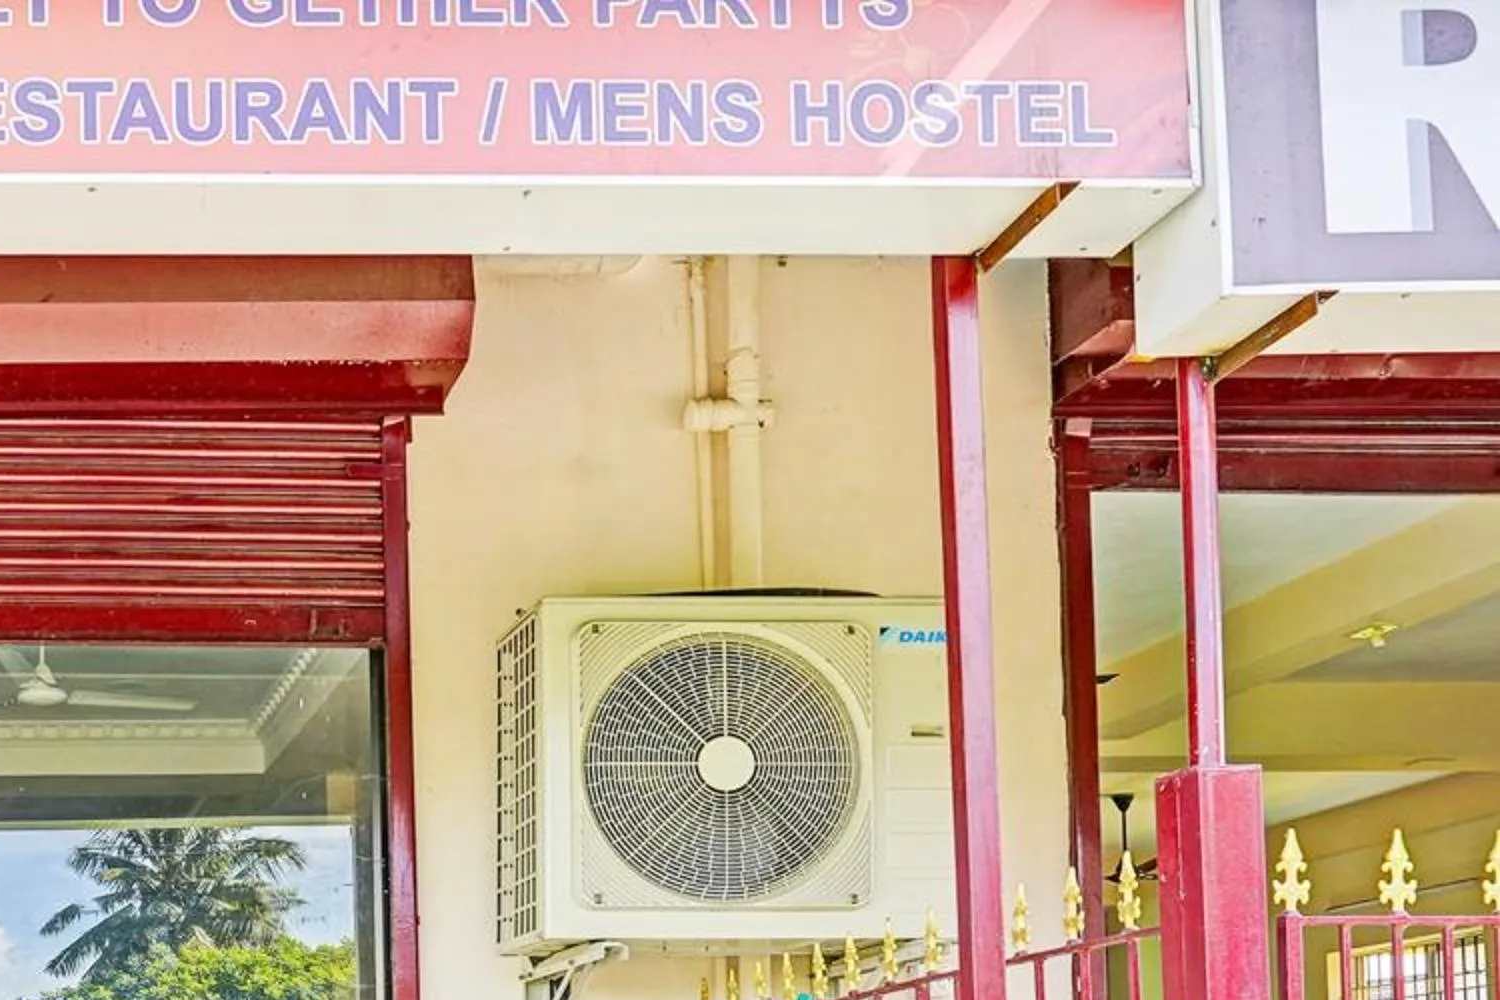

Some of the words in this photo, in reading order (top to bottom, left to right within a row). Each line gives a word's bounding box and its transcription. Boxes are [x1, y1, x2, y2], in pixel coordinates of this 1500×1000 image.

[480, 79, 506, 144] /
[532, 79, 762, 146] MENS
[792, 80, 1117, 147] HOSTEL
[899, 630, 948, 643] DAIK
